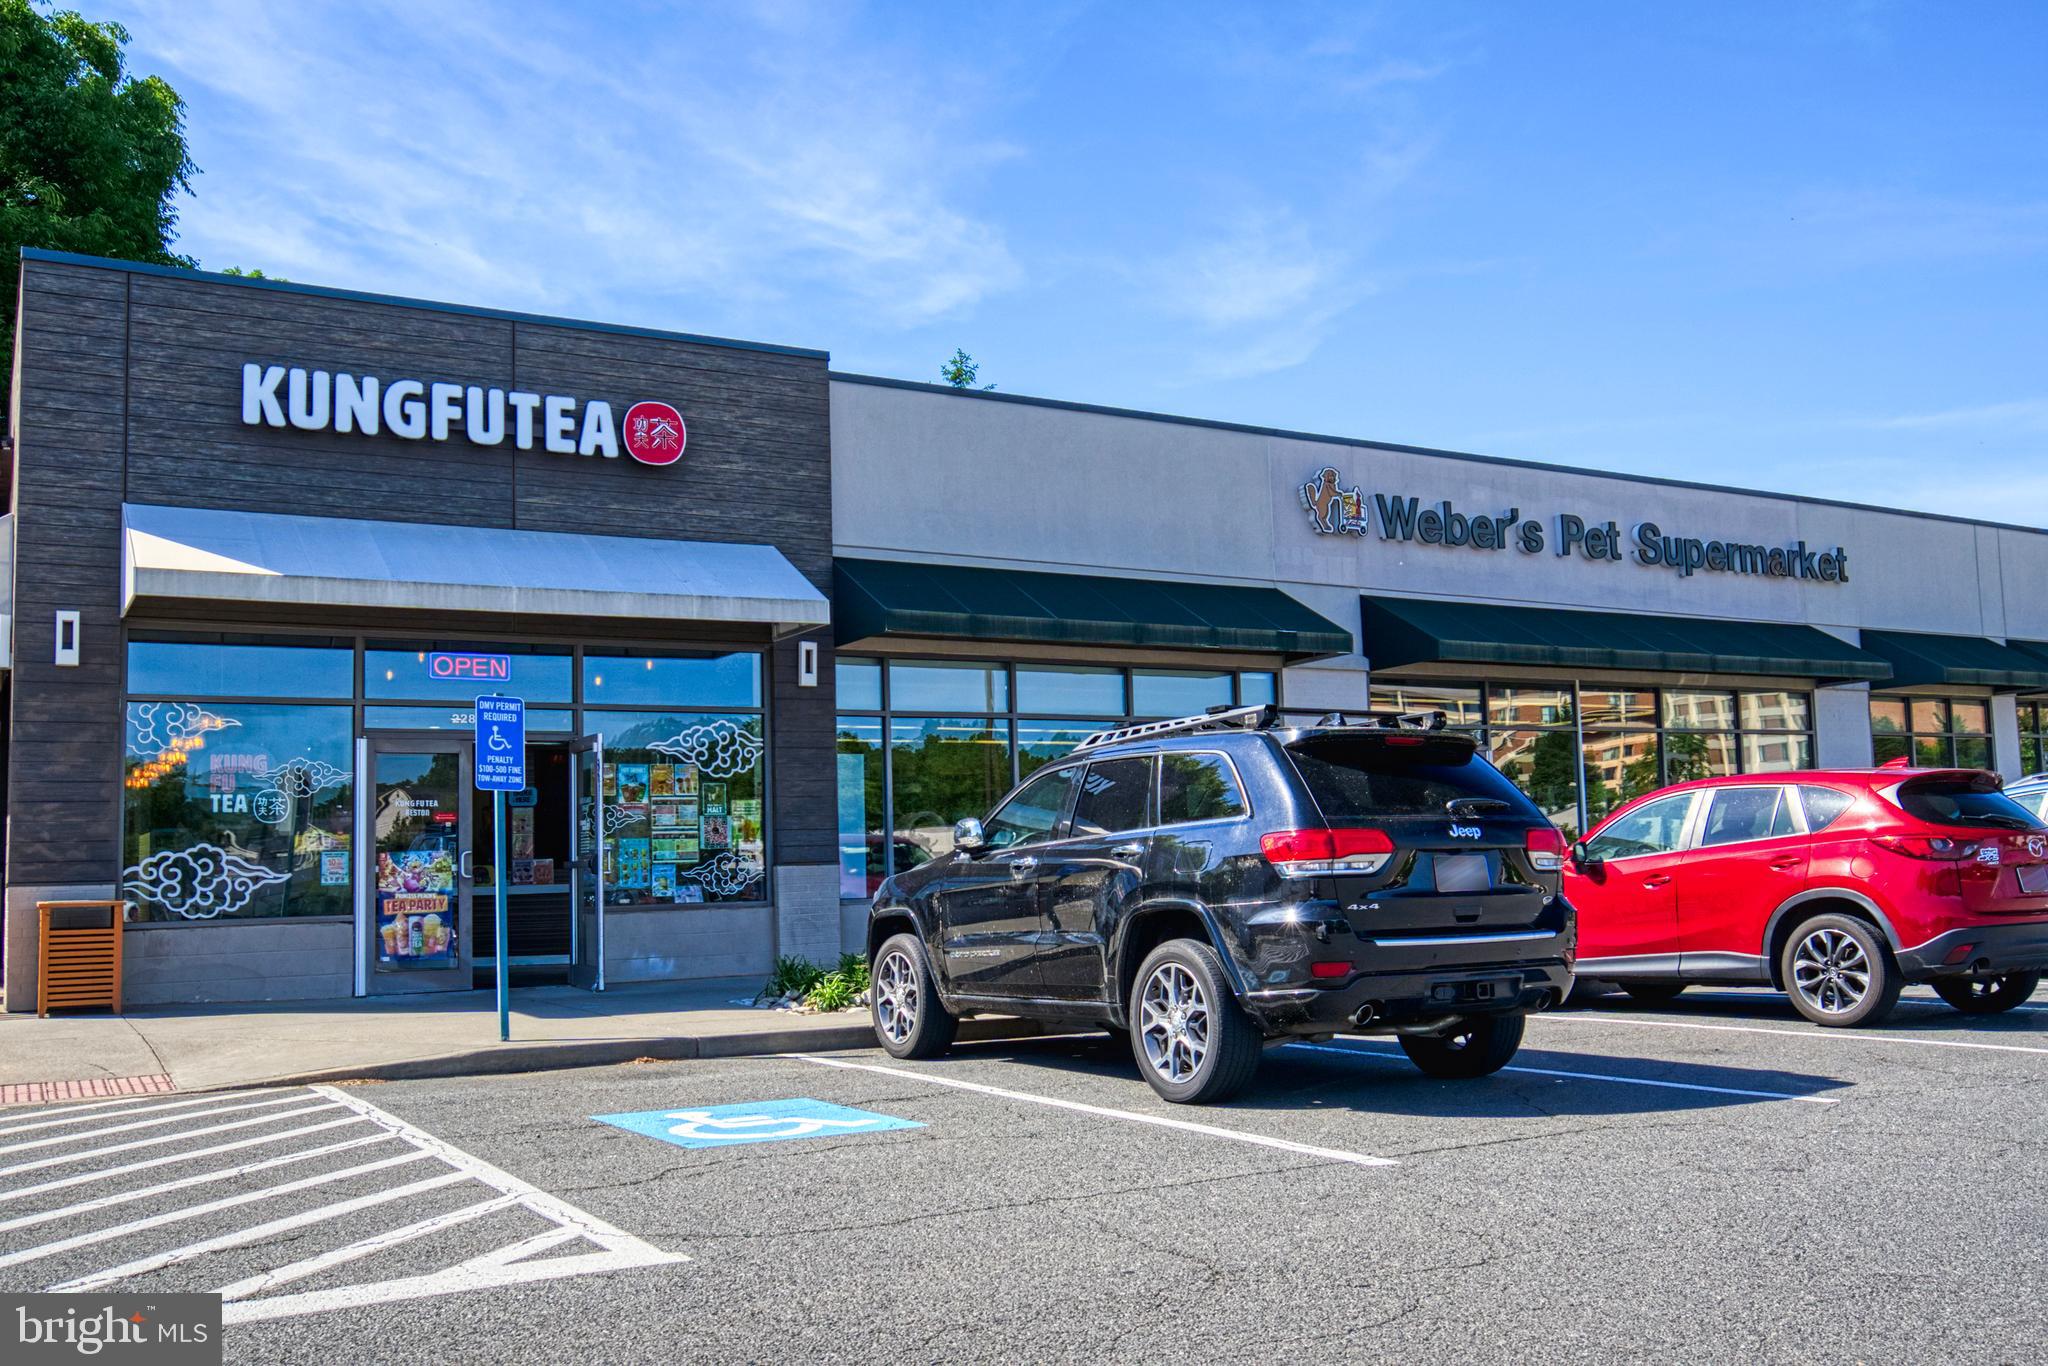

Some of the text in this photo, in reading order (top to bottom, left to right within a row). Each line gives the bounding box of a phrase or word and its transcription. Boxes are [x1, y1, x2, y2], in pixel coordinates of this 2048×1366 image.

[241, 363, 619, 459] KUNGFUTEA
[1375, 492, 1849, 583] Weber's Pet Supermarket
[433, 655, 506, 678] OPEN
[479, 700, 522, 712] DMV PERMIT
[483, 712, 517, 722] REQUIRED
[209, 754, 268, 773] KUNG
[487, 755, 514, 764] PENALTY
[478, 764, 522, 774] $100-500 FINE
[209, 773, 235, 793] FU
[478, 774, 523, 784] TOW-AWAY ZONE
[209, 794, 249, 814] TEA
[1449, 823, 1482, 840] Jeep
[386, 898, 446, 913] TEA PARTY
[1346, 903, 1380, 911] 4x4
